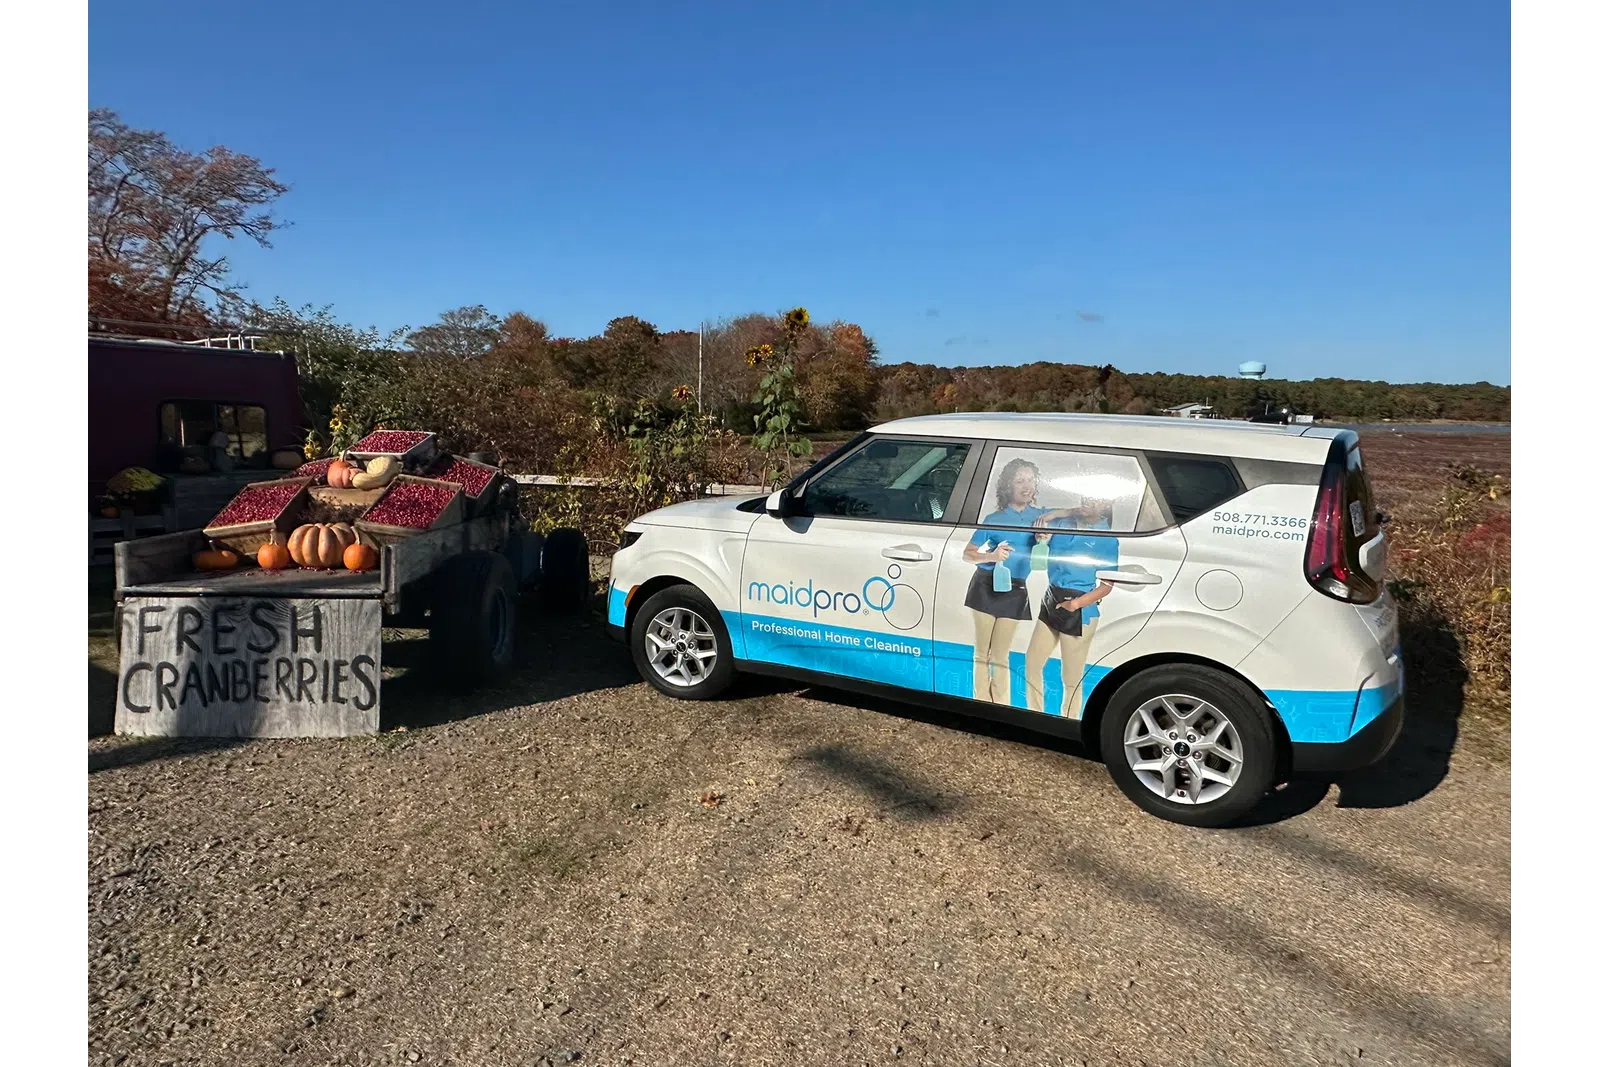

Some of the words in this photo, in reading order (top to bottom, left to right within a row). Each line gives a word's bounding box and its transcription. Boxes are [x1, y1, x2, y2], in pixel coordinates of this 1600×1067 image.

[1212, 525, 1305, 542] maidpro.com
[1213, 511, 1307, 529] 508.771.3366
[137, 602, 322, 656] FRESH
[752, 620, 821, 640] Professional
[824, 631, 860, 646] Home
[864, 637, 921, 657] Cleaning
[122, 655, 377, 713] CRANBERRIES
